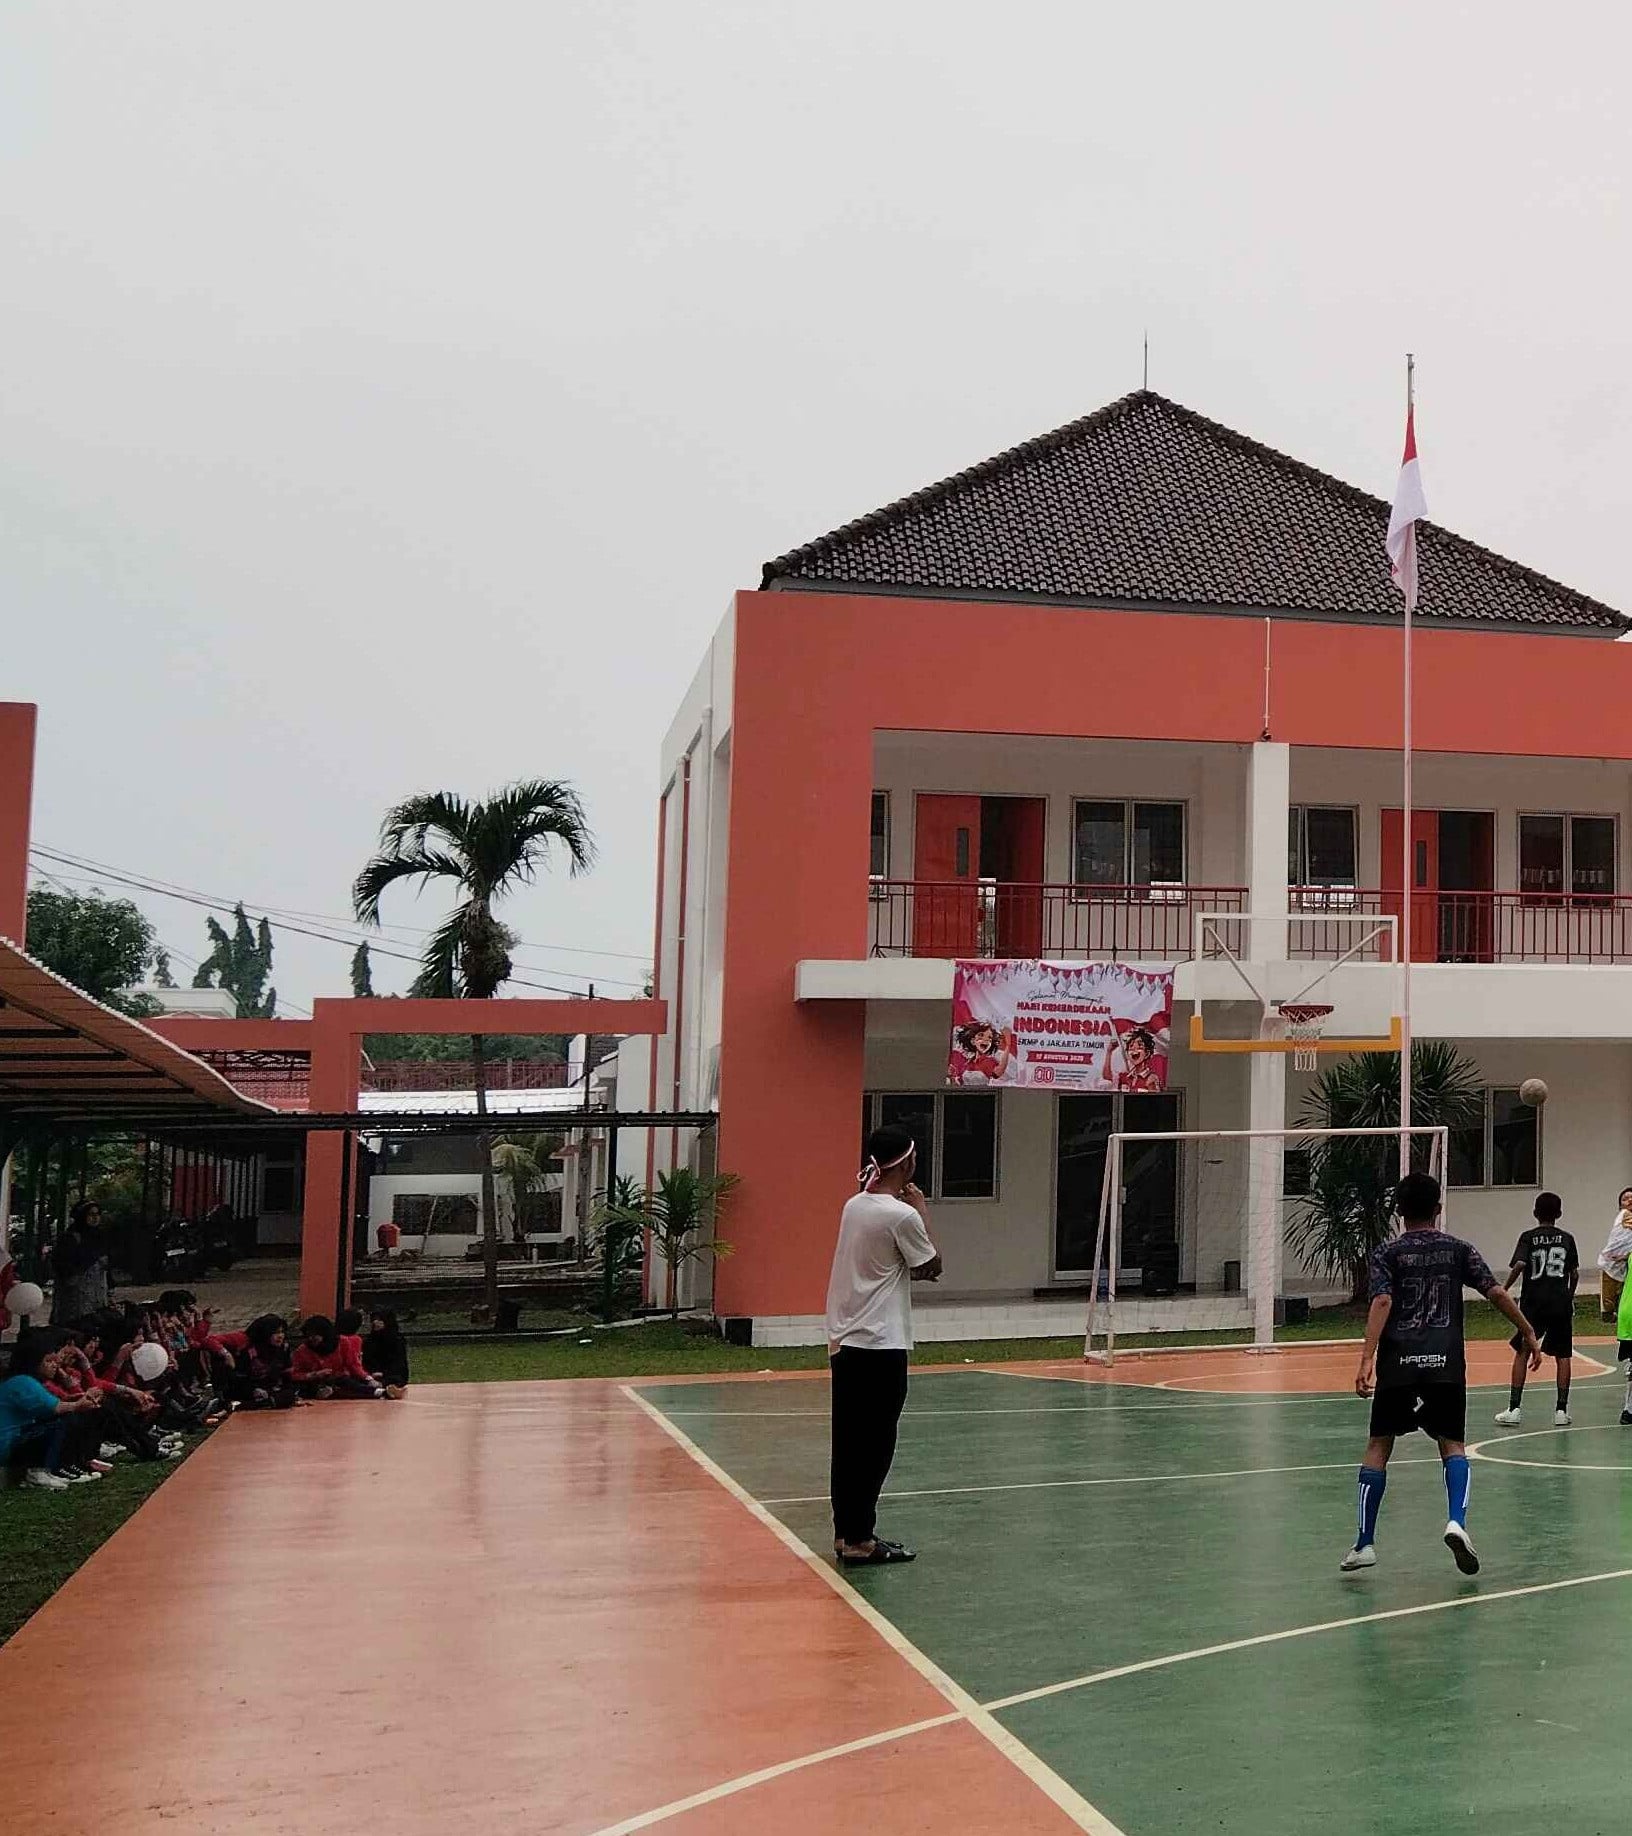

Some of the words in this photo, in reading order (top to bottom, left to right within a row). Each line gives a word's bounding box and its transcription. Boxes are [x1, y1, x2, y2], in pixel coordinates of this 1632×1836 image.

[1016, 1001, 1041, 1011] HARI
[1041, 1002, 1111, 1015] KEMERDEKAAN
[1013, 1015, 1113, 1036] INDONESIA
[1046, 1039, 1080, 1048] JAKARTA
[1082, 1041, 1105, 1050] TIMUR
